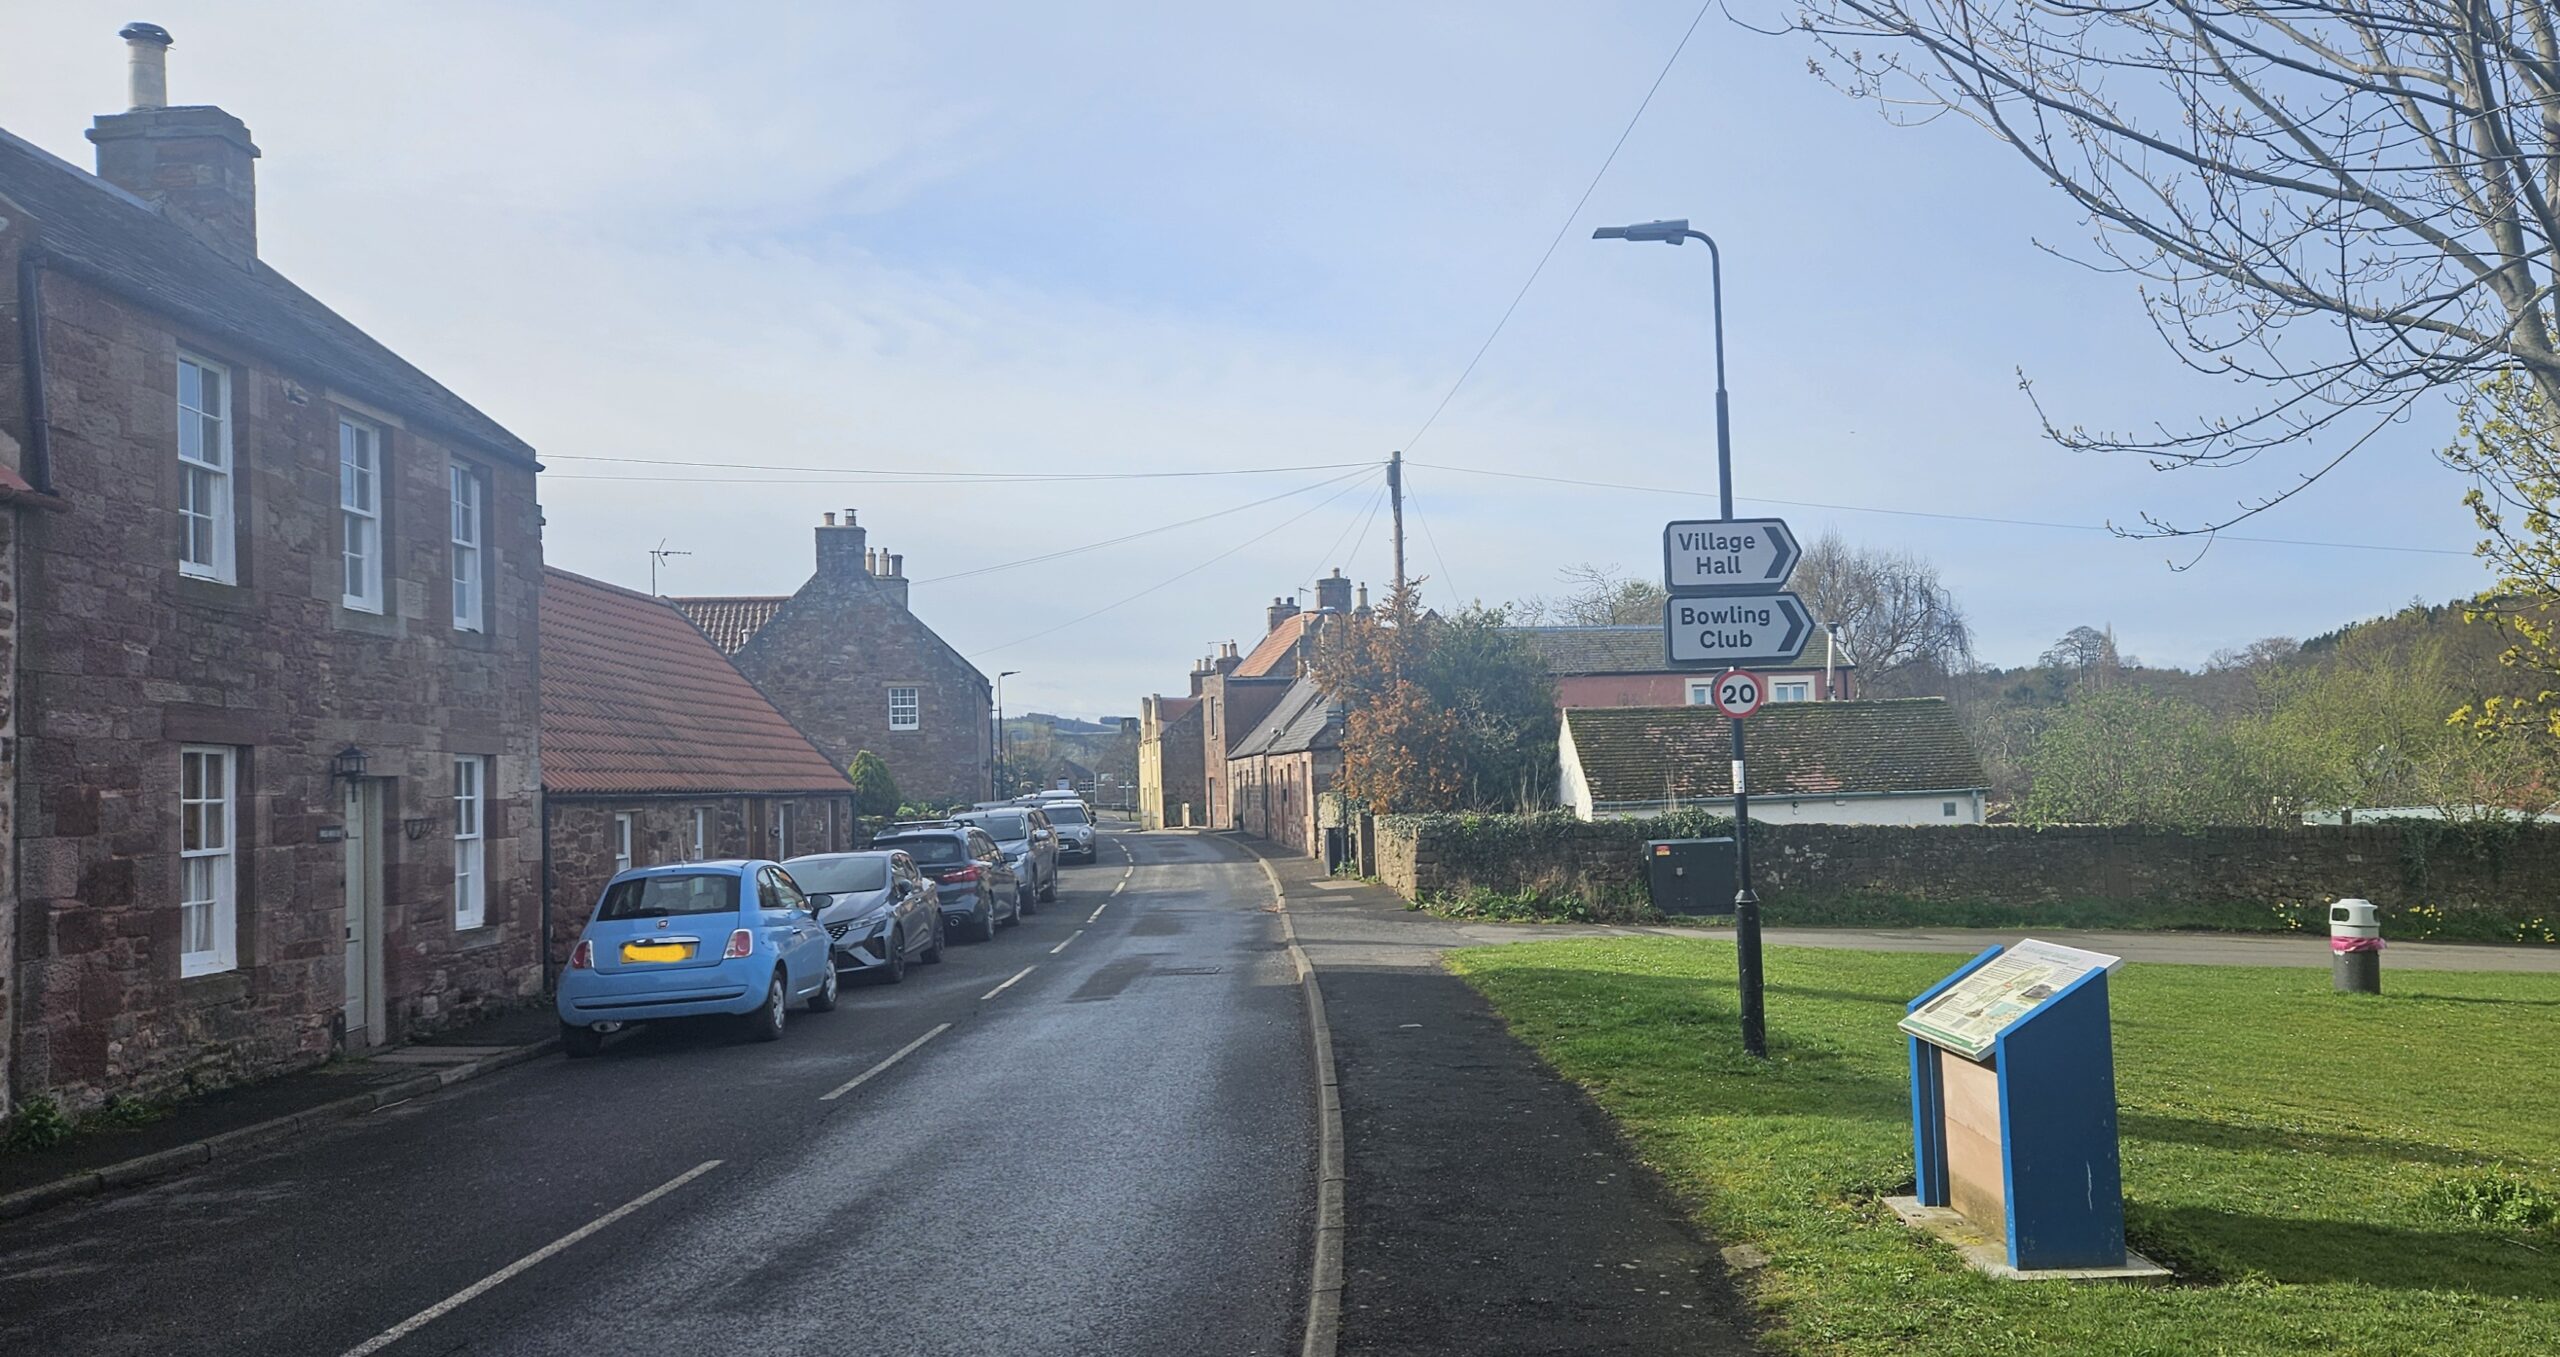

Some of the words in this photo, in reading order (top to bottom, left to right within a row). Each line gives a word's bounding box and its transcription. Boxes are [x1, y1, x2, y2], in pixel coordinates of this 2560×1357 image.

[1678, 532, 1756, 553] Village
[1696, 556, 1742, 575] Hall
[1681, 606, 1770, 626] Bowling
[1700, 629, 1753, 649] Club
[1722, 684, 1755, 704] 20
